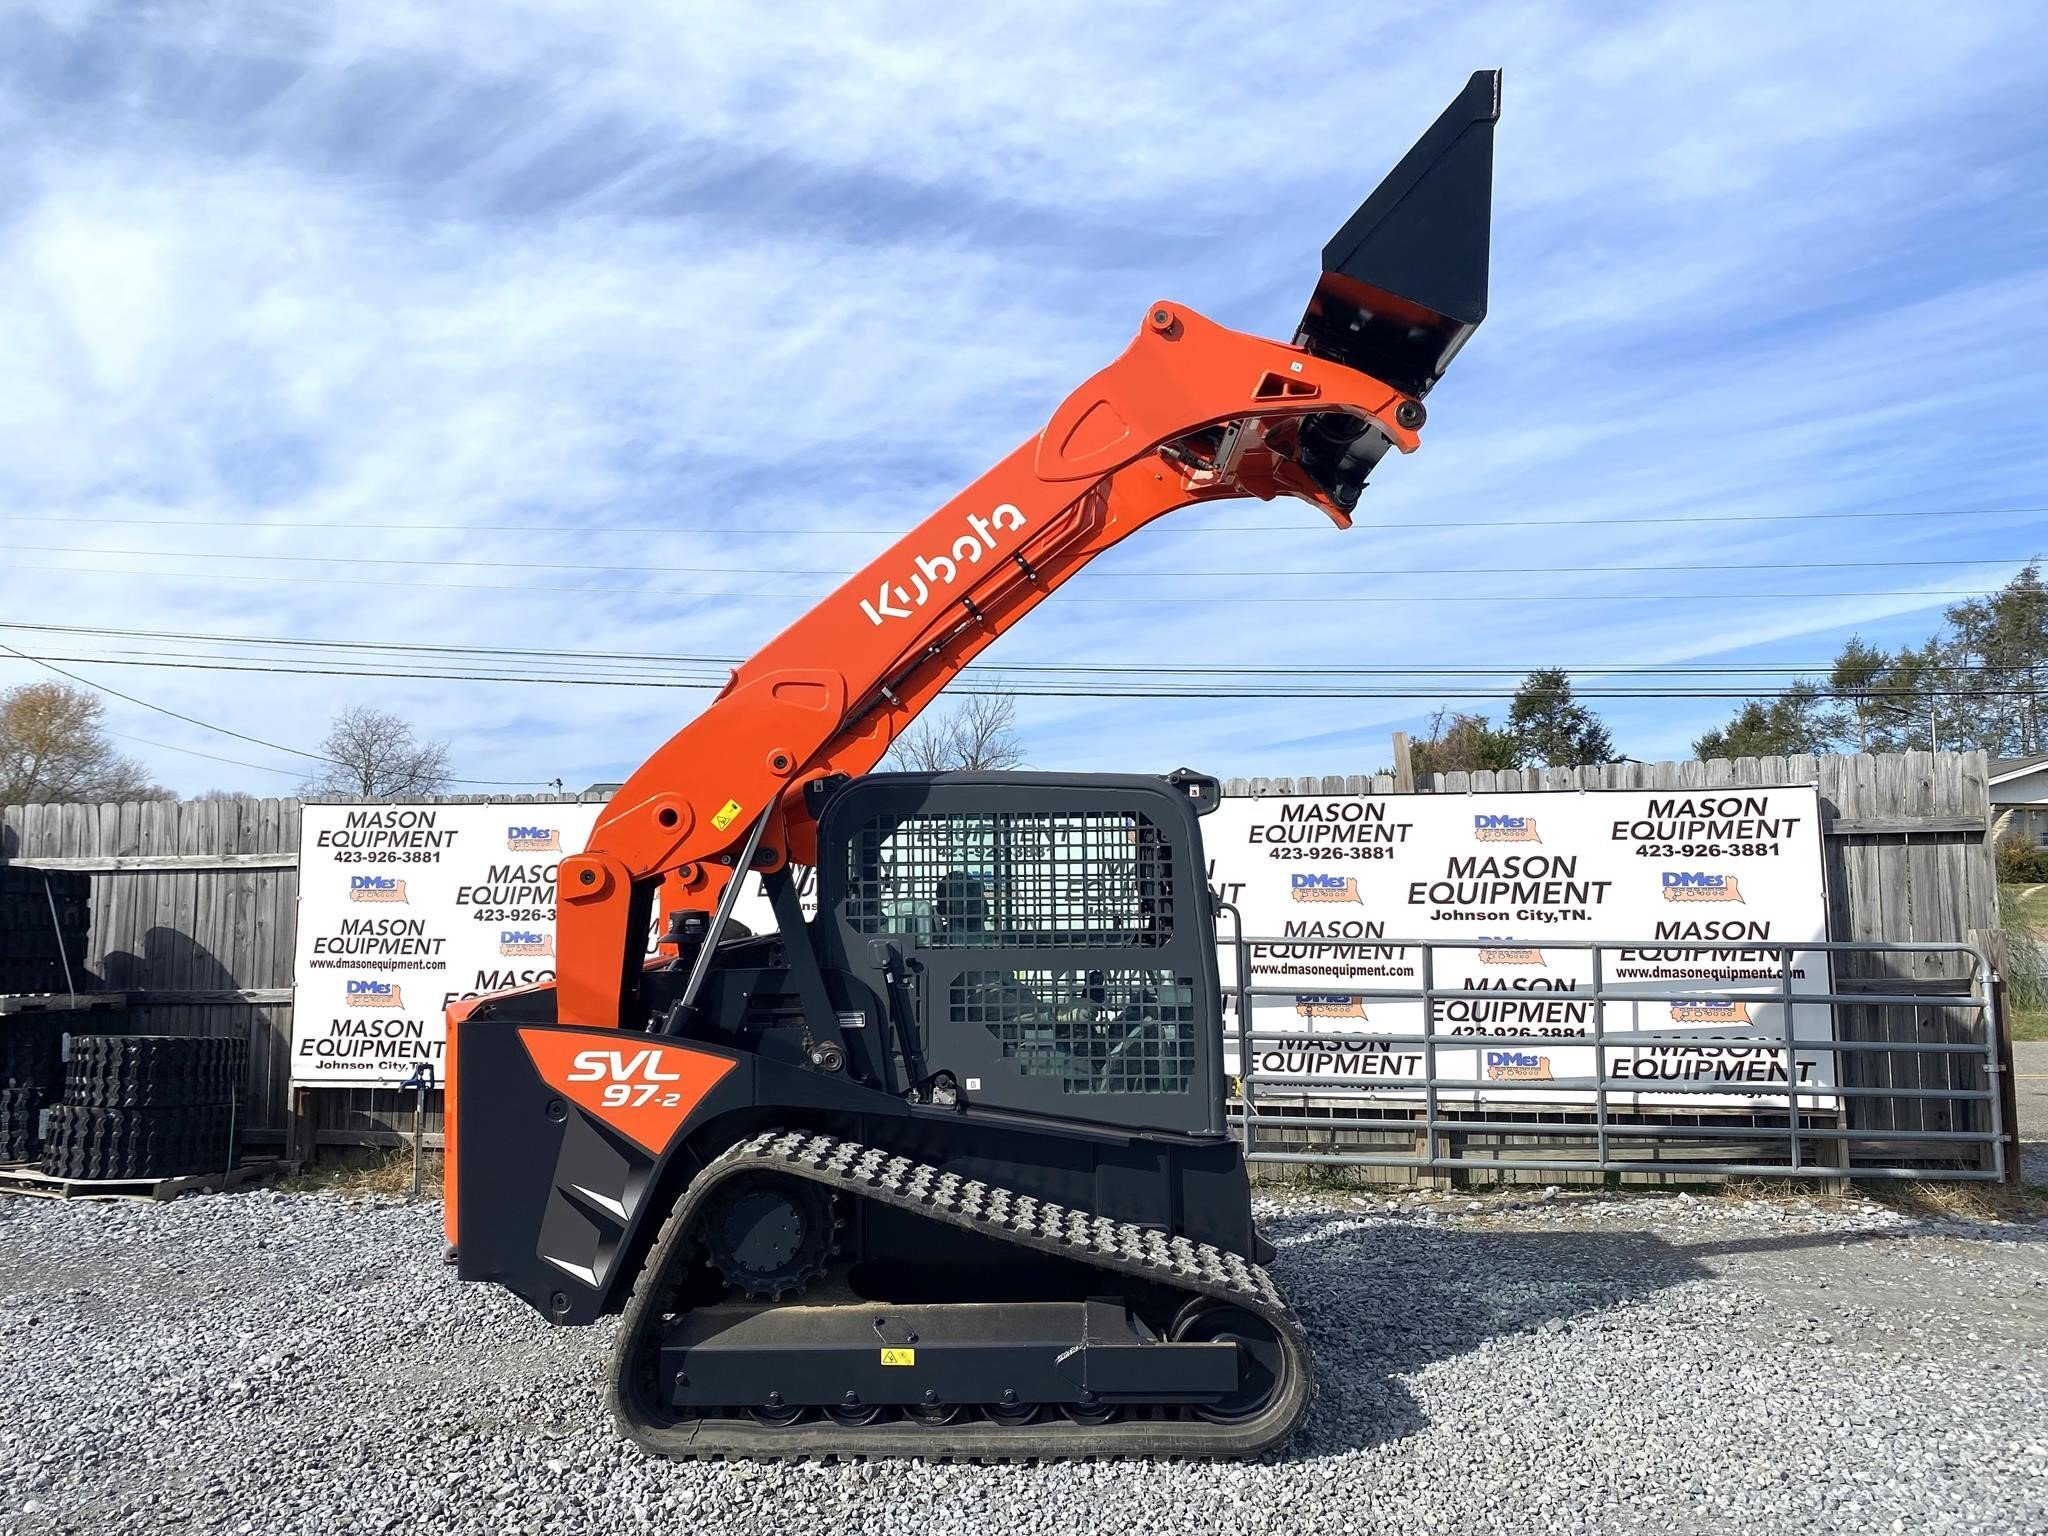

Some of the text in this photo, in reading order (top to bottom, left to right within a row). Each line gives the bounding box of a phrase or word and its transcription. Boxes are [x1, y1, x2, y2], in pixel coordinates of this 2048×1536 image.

[859, 503, 1027, 626] Kubota
[1280, 802, 1386, 823] MASON
[1647, 797, 1769, 819] MASON
[345, 811, 436, 829] MASON
[1611, 818, 1801, 841] EQUIPMENT
[316, 830, 459, 848] EQUIPMENT
[1248, 823, 1413, 844] EQUIPMENT
[333, 851, 441, 864] 423-926-3881
[1269, 847, 1394, 860] 423-926-3881
[1635, 843, 1780, 857] 423-926-3881
[486, 865, 558, 884] MASO
[1447, 855, 1577, 879] MASON
[456, 886, 557, 906] EQUIPM
[1408, 881, 1612, 905] EQUIPMENT
[473, 908, 556, 922] 423-926-3
[1430, 909, 1592, 924] Johnson City,TN.
[340, 919, 425, 936] MASON
[1284, 921, 1385, 939] MASON
[1654, 921, 1770, 940] MASON
[313, 937, 446, 955] EQUIPMENT
[309, 957, 446, 972] www.dmasonequipment.com
[1250, 963, 1414, 978] www.dmasonequipment.com
[330, 1019, 424, 1038] MASON
[299, 1039, 446, 1058] EQUIPMENT
[315, 1061, 374, 1070] Johnson
[567, 1050, 681, 1081] SVL
[1611, 1059, 1816, 1082] EQUIPMENT
[601, 1084, 681, 1107] 97-2
